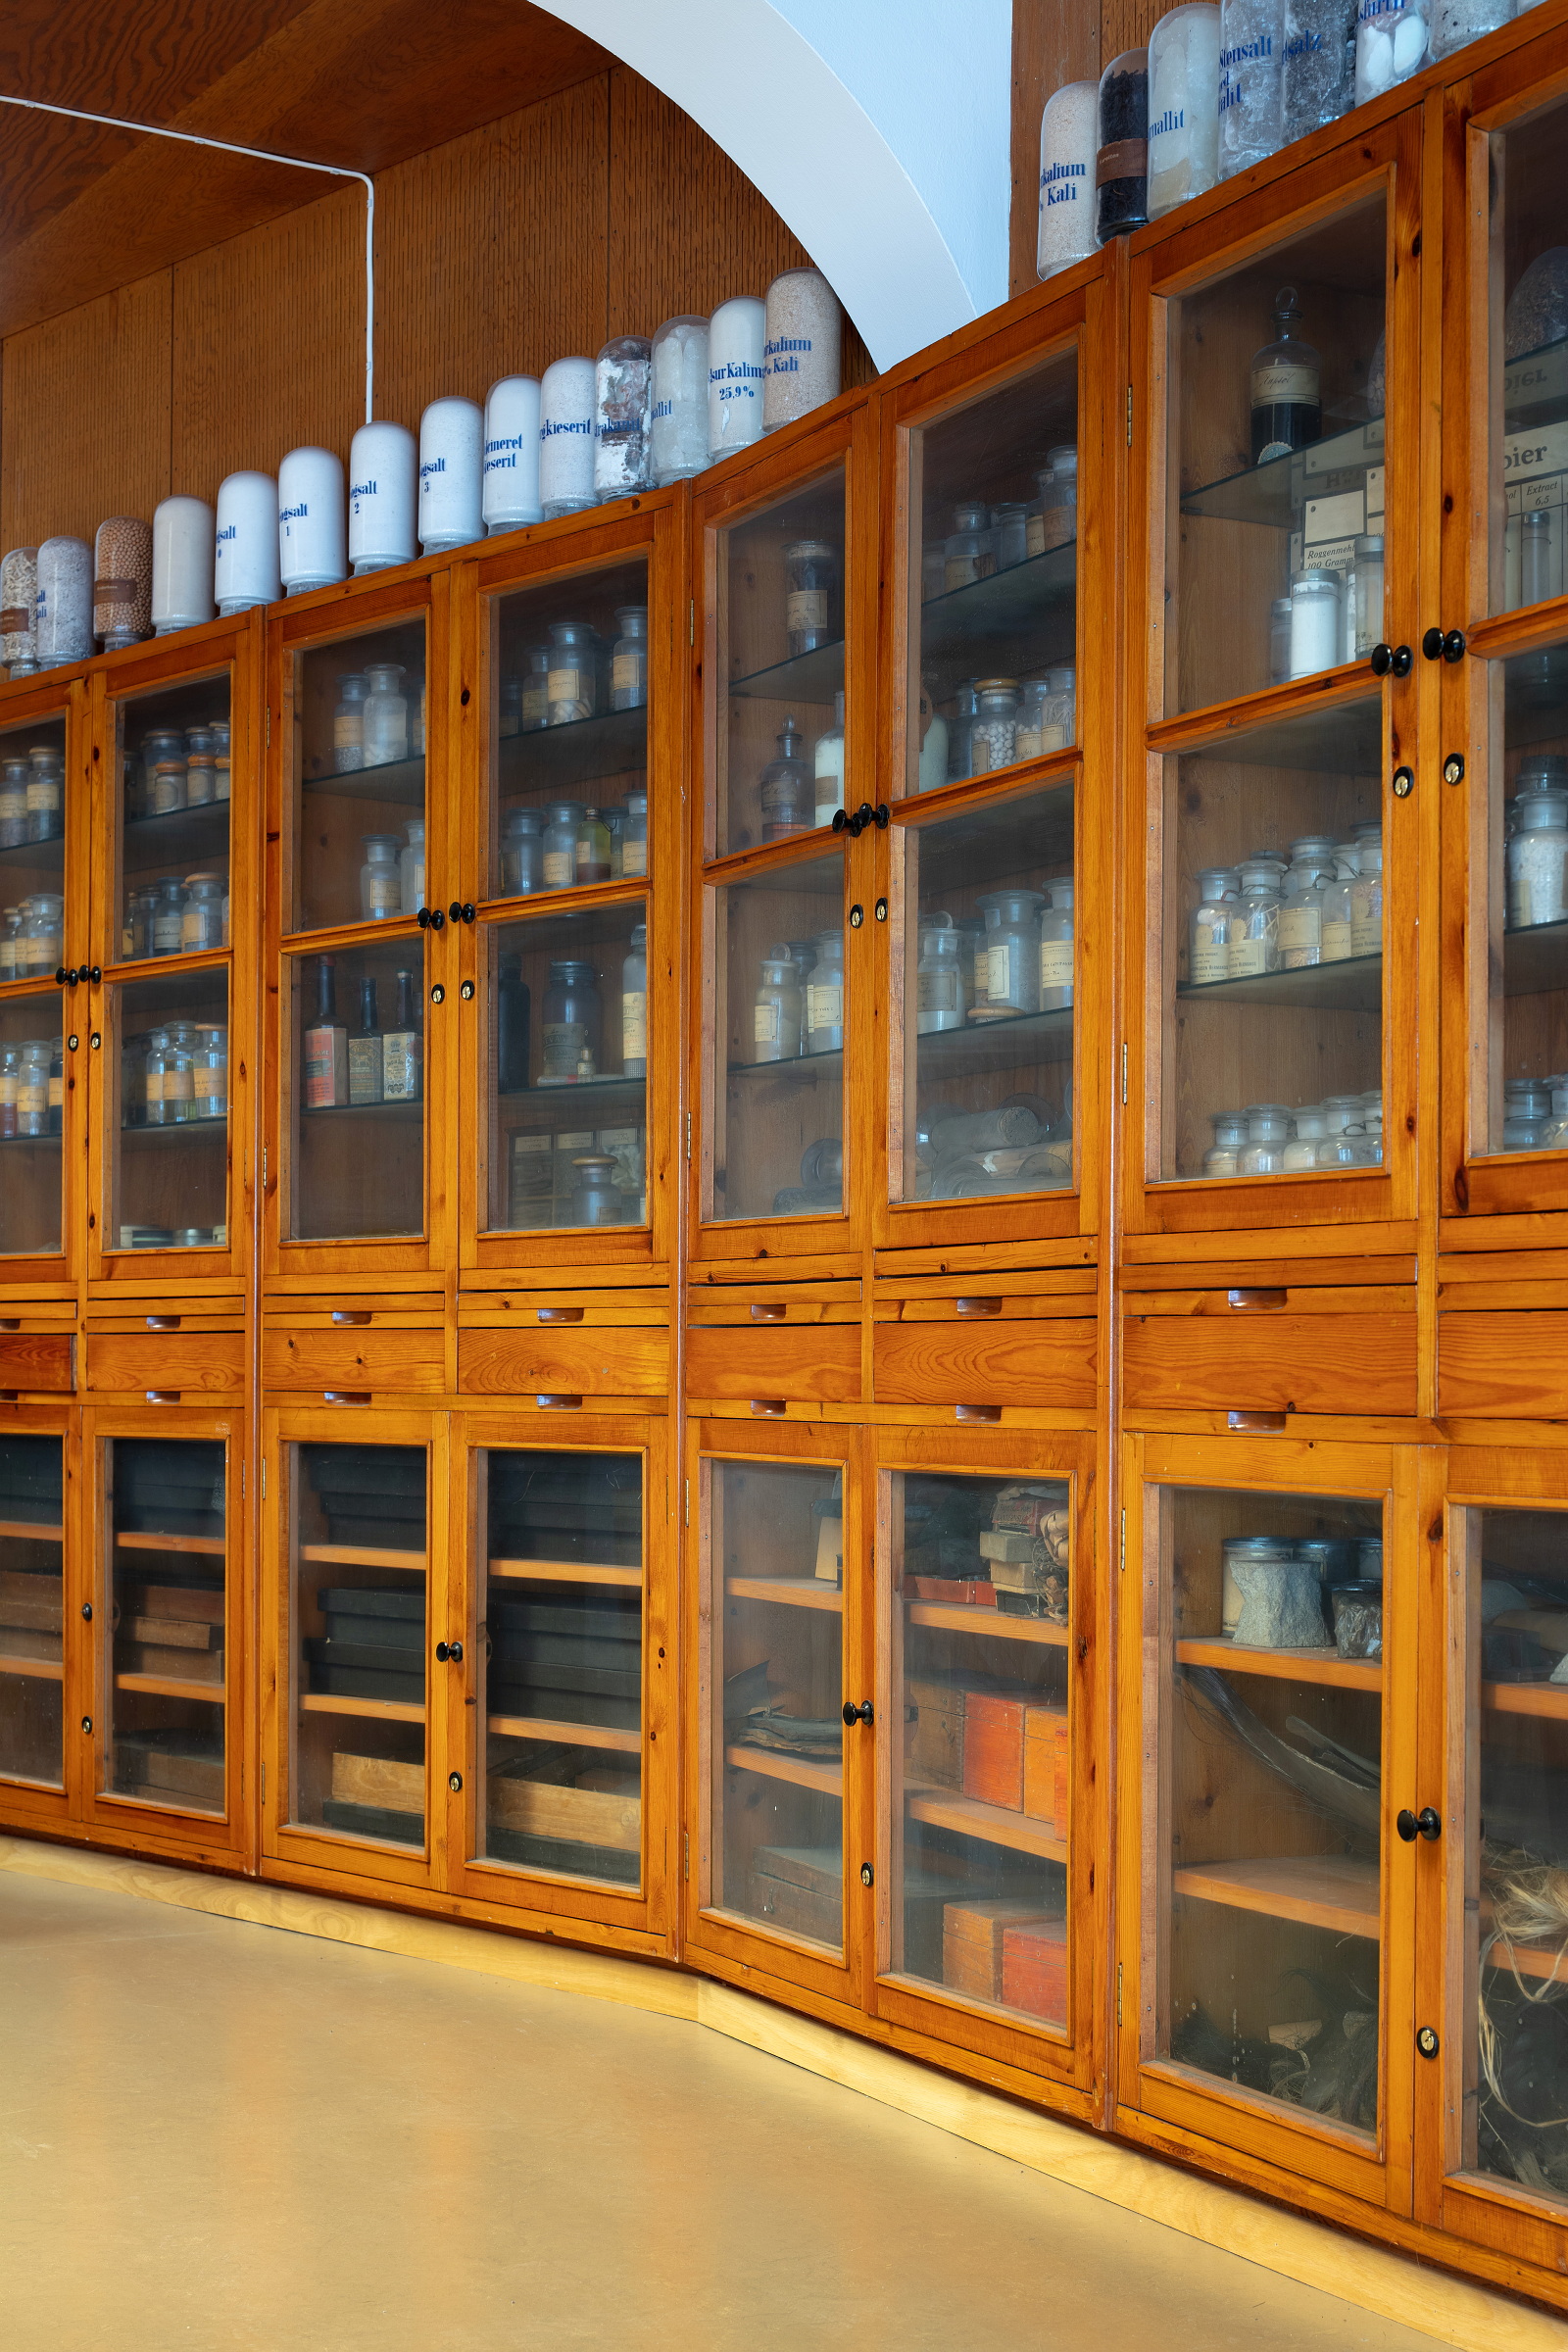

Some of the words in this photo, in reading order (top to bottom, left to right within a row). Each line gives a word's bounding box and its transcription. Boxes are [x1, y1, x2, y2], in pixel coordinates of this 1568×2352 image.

[1047, 183, 1077, 206] Kali
[773, 356, 799, 373] Kali
[424, 482, 430, 493] 3
[1526, 481, 1558, 496] Extract
[1535, 495, 1550, 506] 6,5
[354, 503, 360, 514] 2
[286, 525, 291, 536] 1
